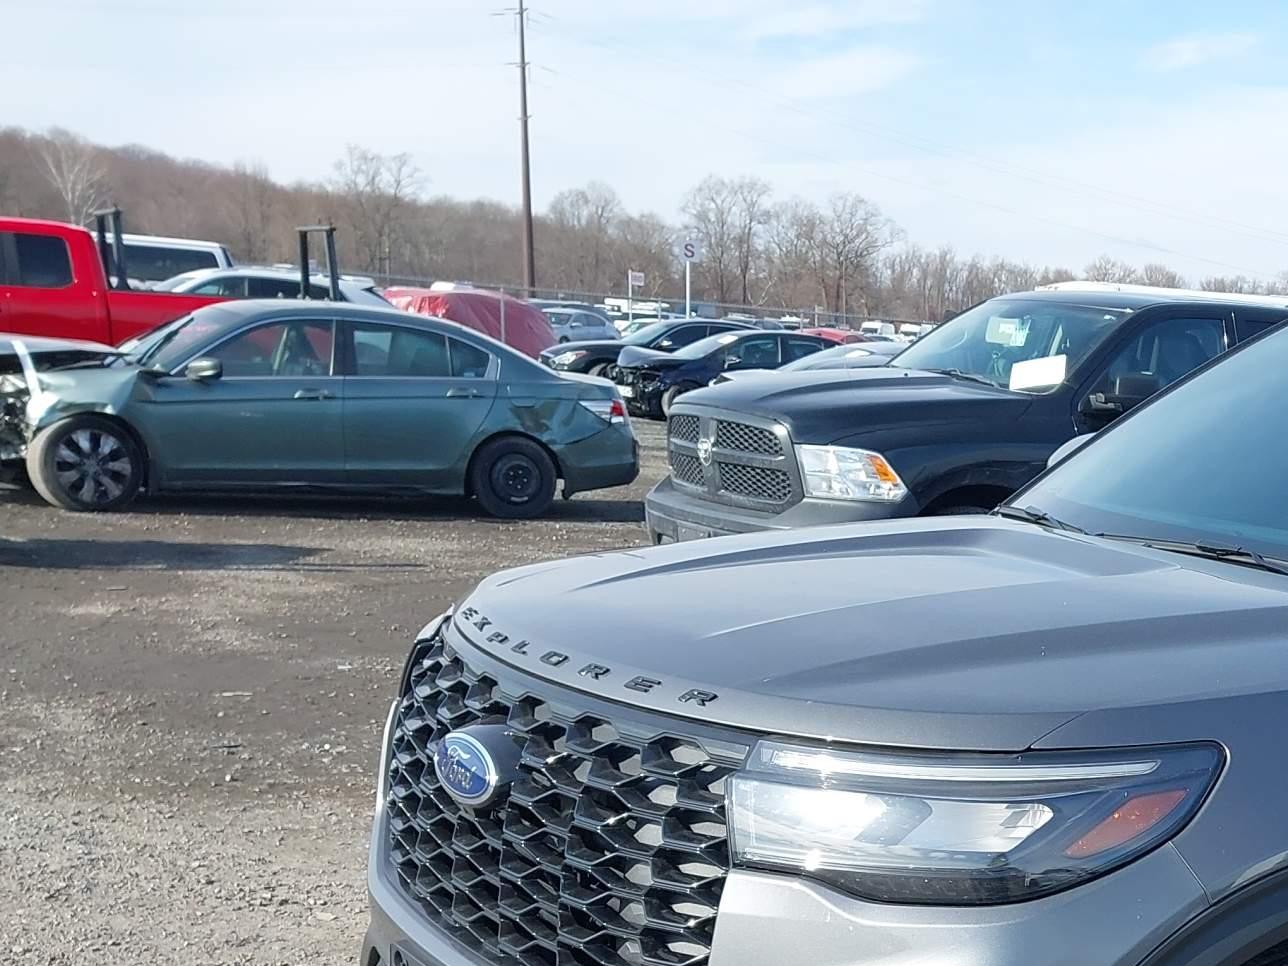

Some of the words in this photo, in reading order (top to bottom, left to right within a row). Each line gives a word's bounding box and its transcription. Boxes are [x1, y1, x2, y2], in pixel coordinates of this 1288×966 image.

[684, 243, 695, 258] S
[460, 606, 719, 706] EXPLORER
[441, 744, 477, 791] Ford
